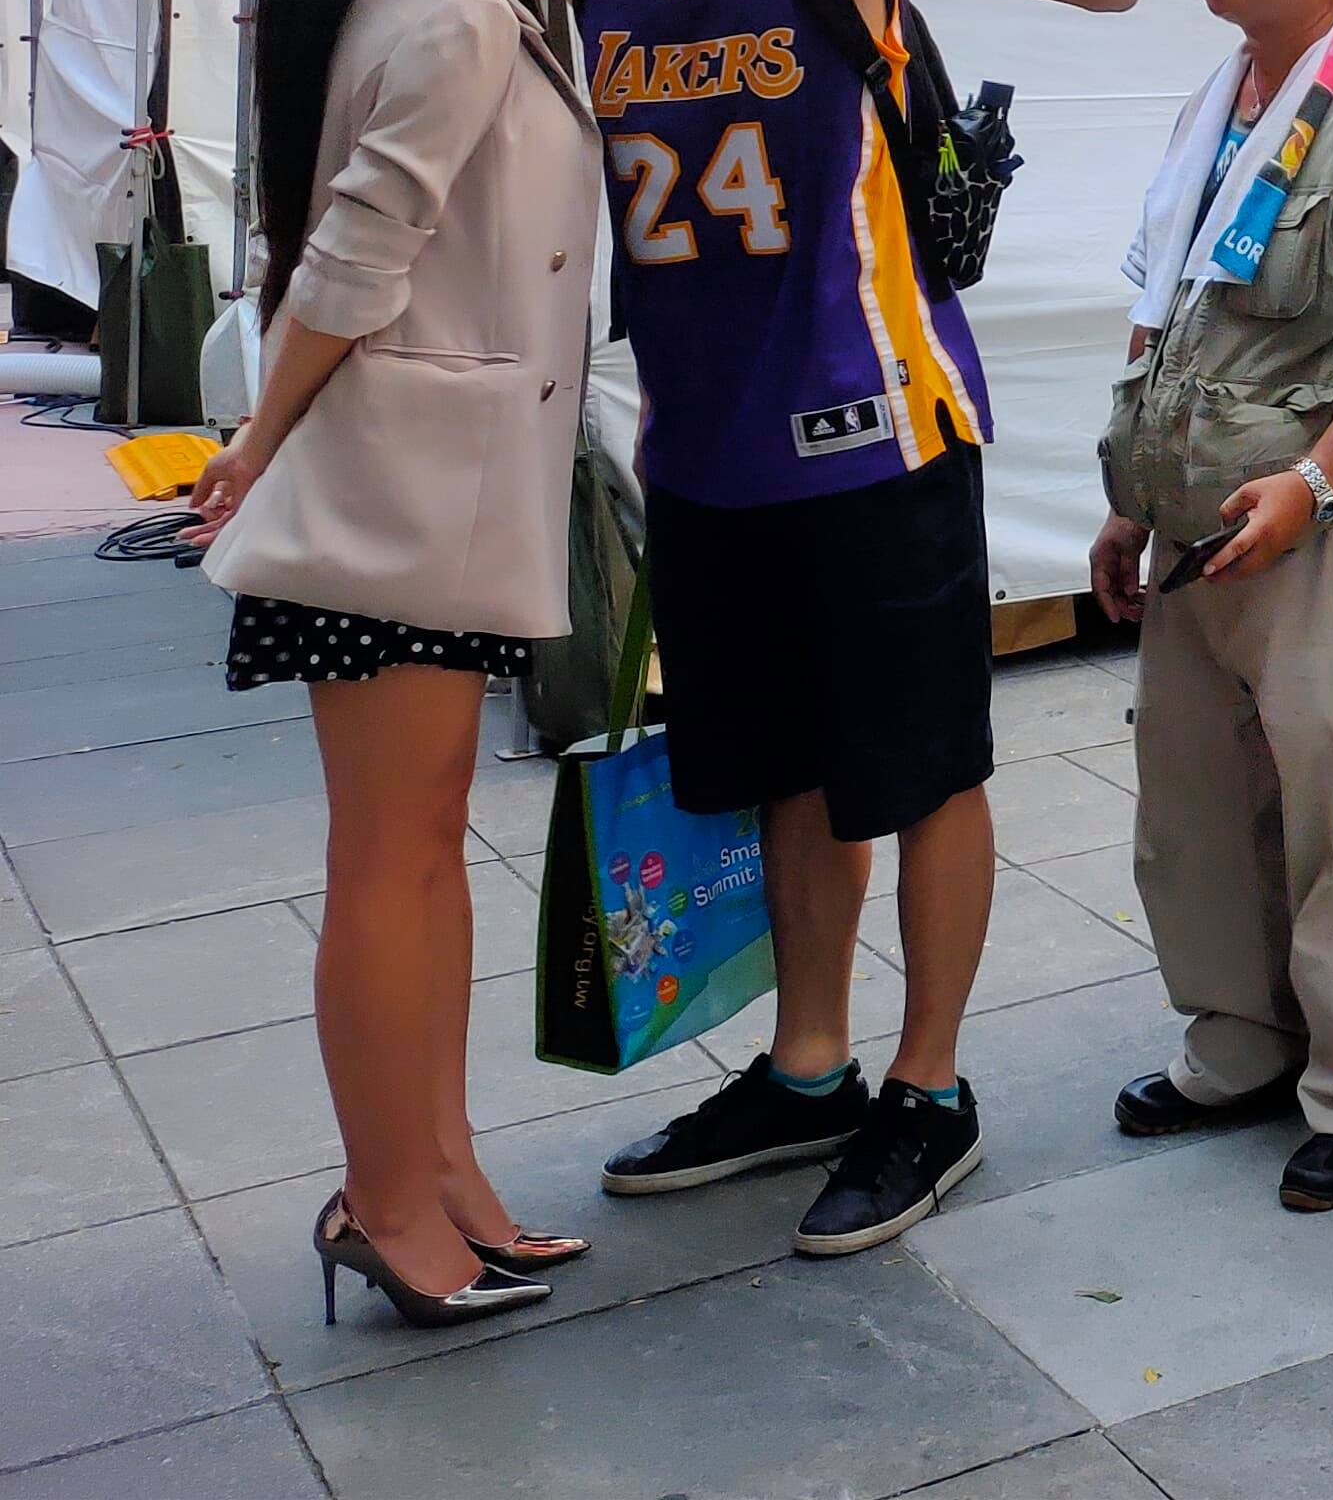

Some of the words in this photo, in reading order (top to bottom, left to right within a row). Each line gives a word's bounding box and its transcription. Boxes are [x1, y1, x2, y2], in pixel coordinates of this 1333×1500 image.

[591, 28, 805, 118] LAKERS
[608, 122, 791, 265] 24
[693, 866, 757, 907] Summit
